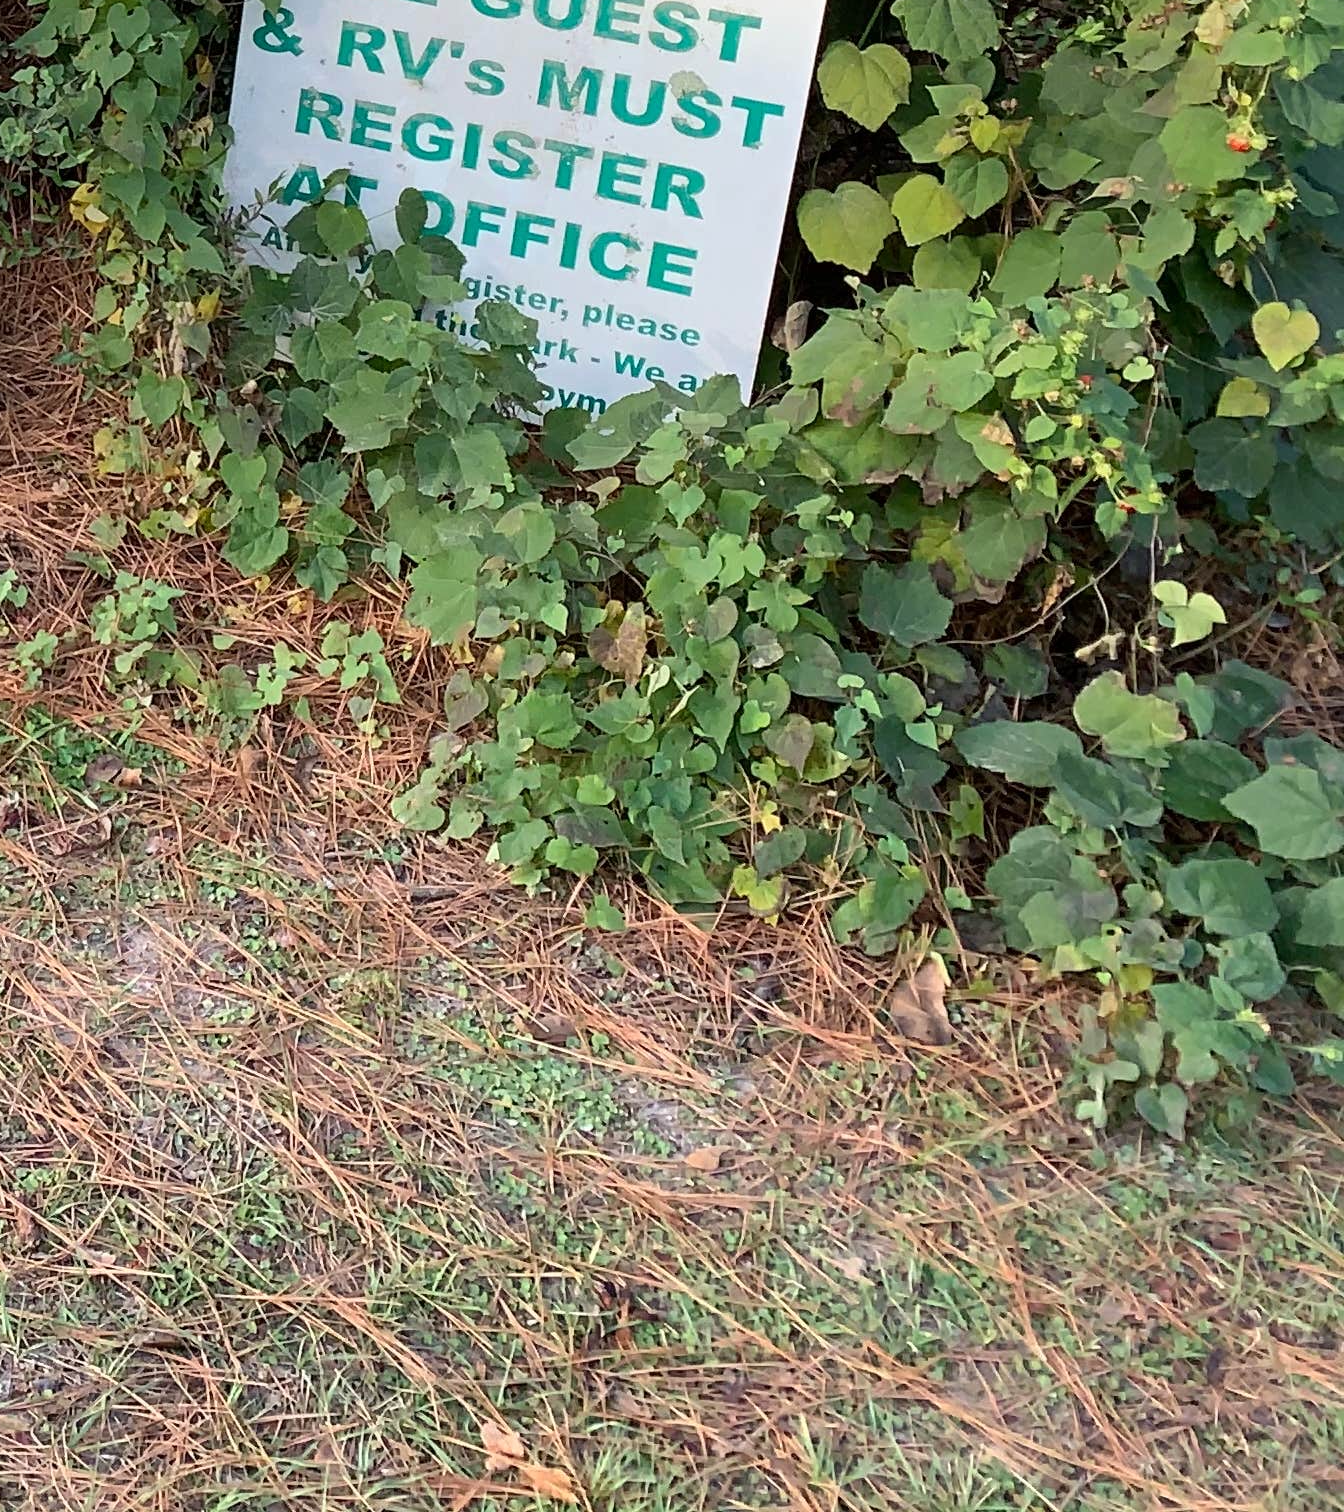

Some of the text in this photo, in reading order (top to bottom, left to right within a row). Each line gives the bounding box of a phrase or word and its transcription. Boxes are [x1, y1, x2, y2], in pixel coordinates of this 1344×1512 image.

[252, 6, 785, 151] & RV's MUST
[295, 87, 706, 221] REGISTER
[420, 193, 698, 297] OFFICE
[463, 274, 701, 346] gister, please
[615, 351, 665, 384] We
